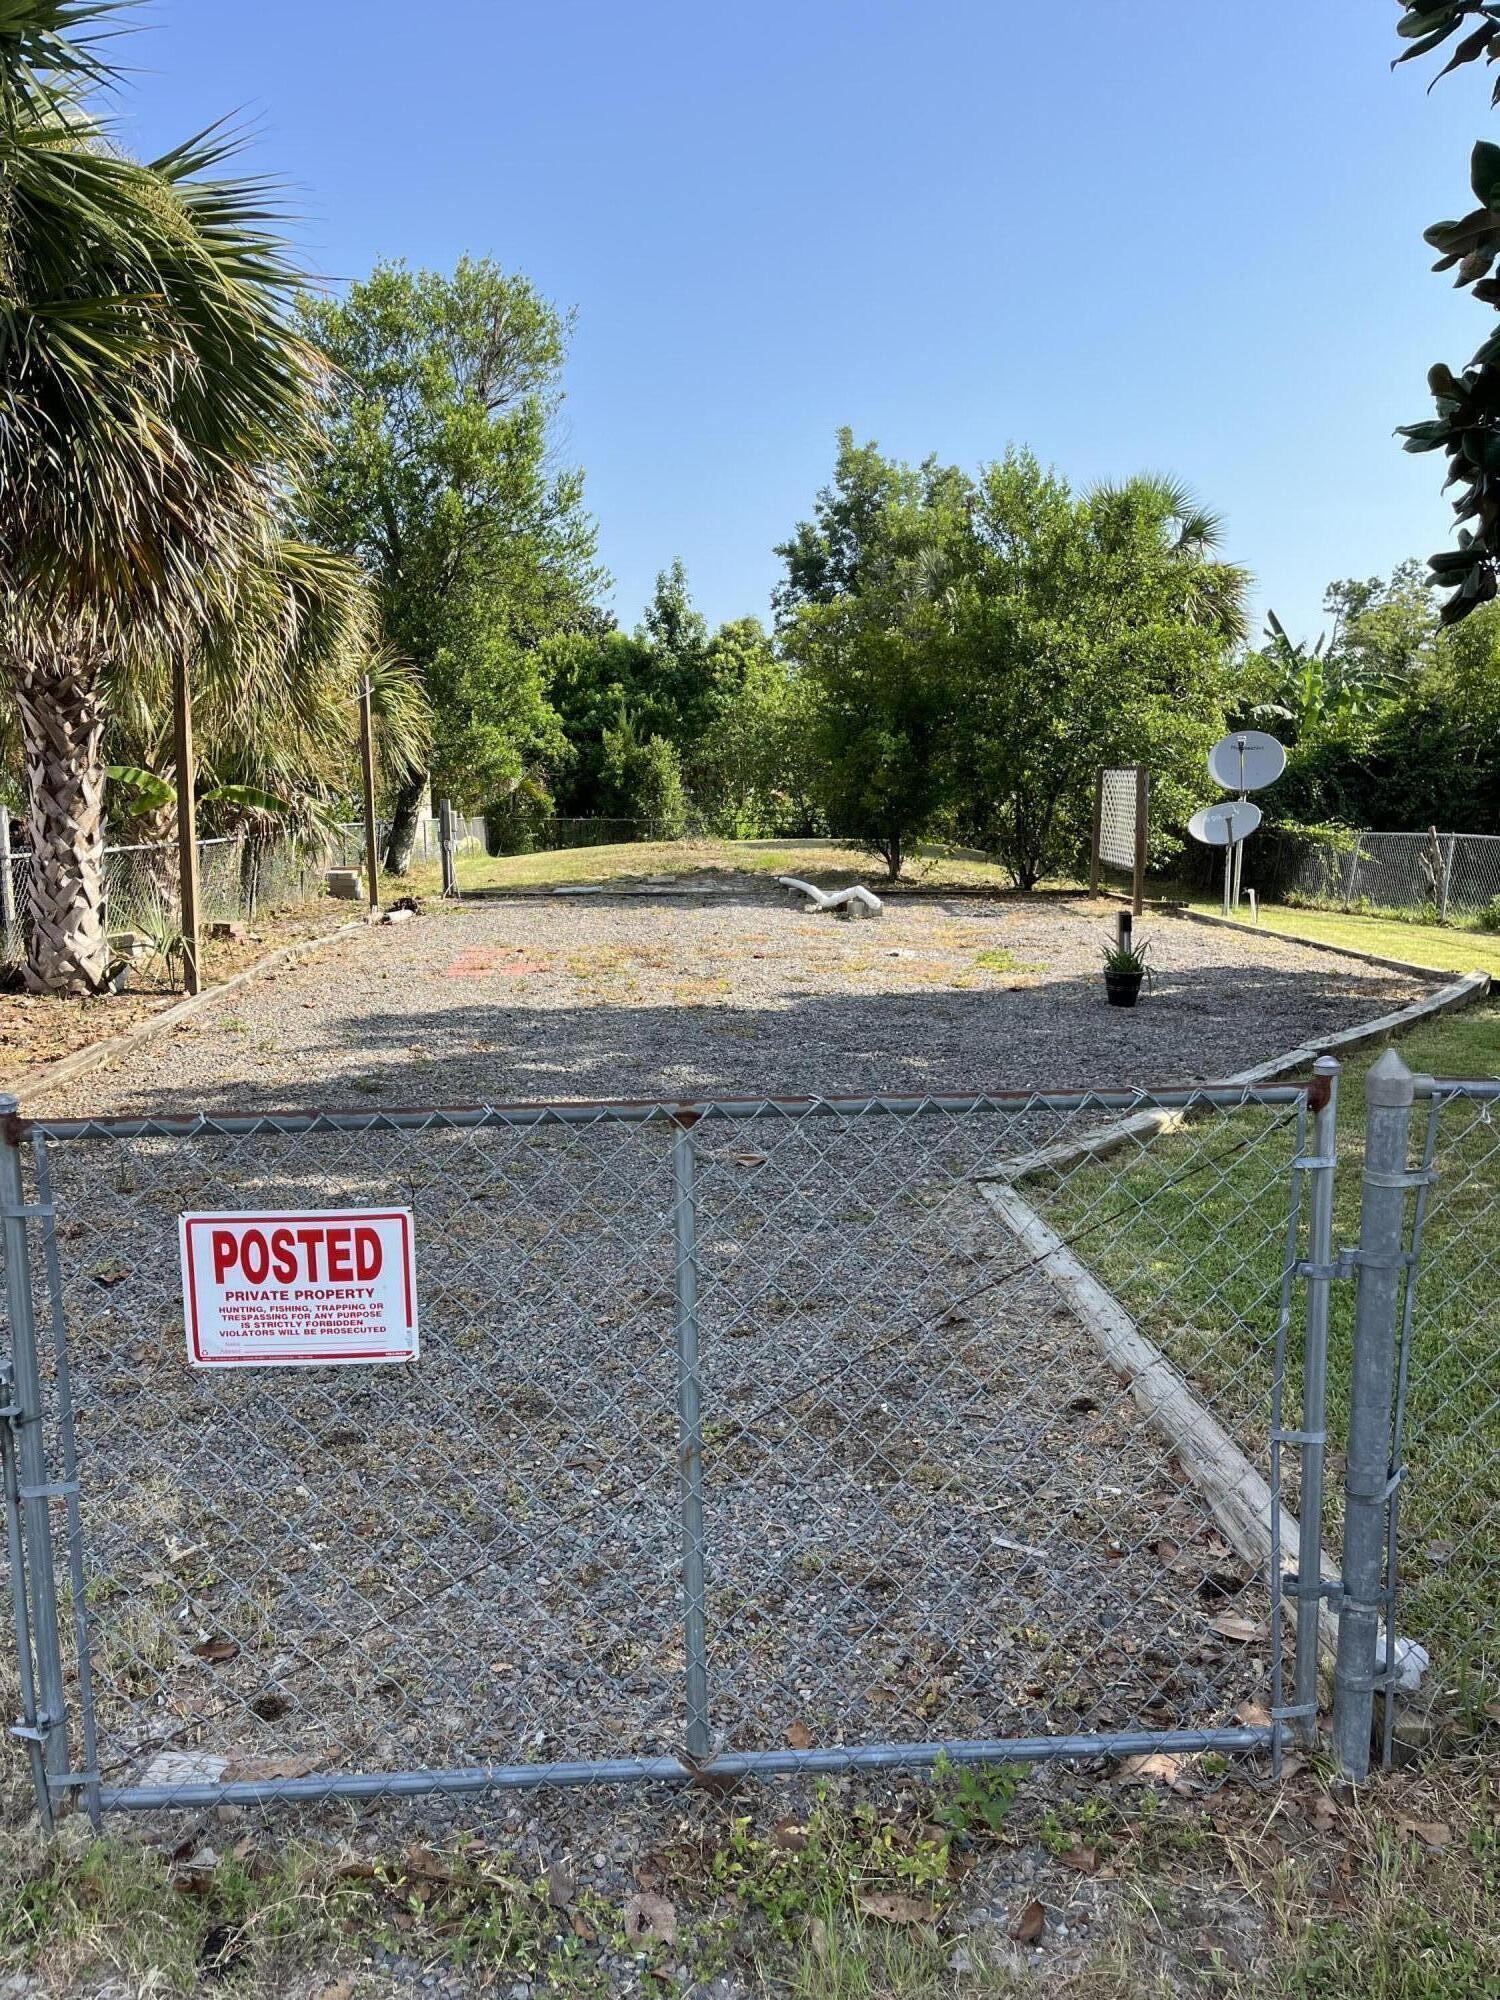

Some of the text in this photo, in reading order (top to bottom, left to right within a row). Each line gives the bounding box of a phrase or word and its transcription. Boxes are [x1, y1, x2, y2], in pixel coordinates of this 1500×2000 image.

[212, 1228, 382, 1284] POSTED
[225, 1288, 375, 1301] PRIVATE PROPERTY
[219, 1305, 266, 1313] HUNTING,
[270, 1304, 312, 1312] FISHING,
[316, 1303, 366, 1311] TRAPPING
[222, 1310, 382, 1321] TRESPASSING FOR ANY PURPOSE
[305, 1319, 363, 1327] FORBIDDEN
[219, 1329, 275, 1337] VIOLATORS
[279, 1328, 299, 1336] WILL
[320, 1327, 386, 1335] PROSECUTED
